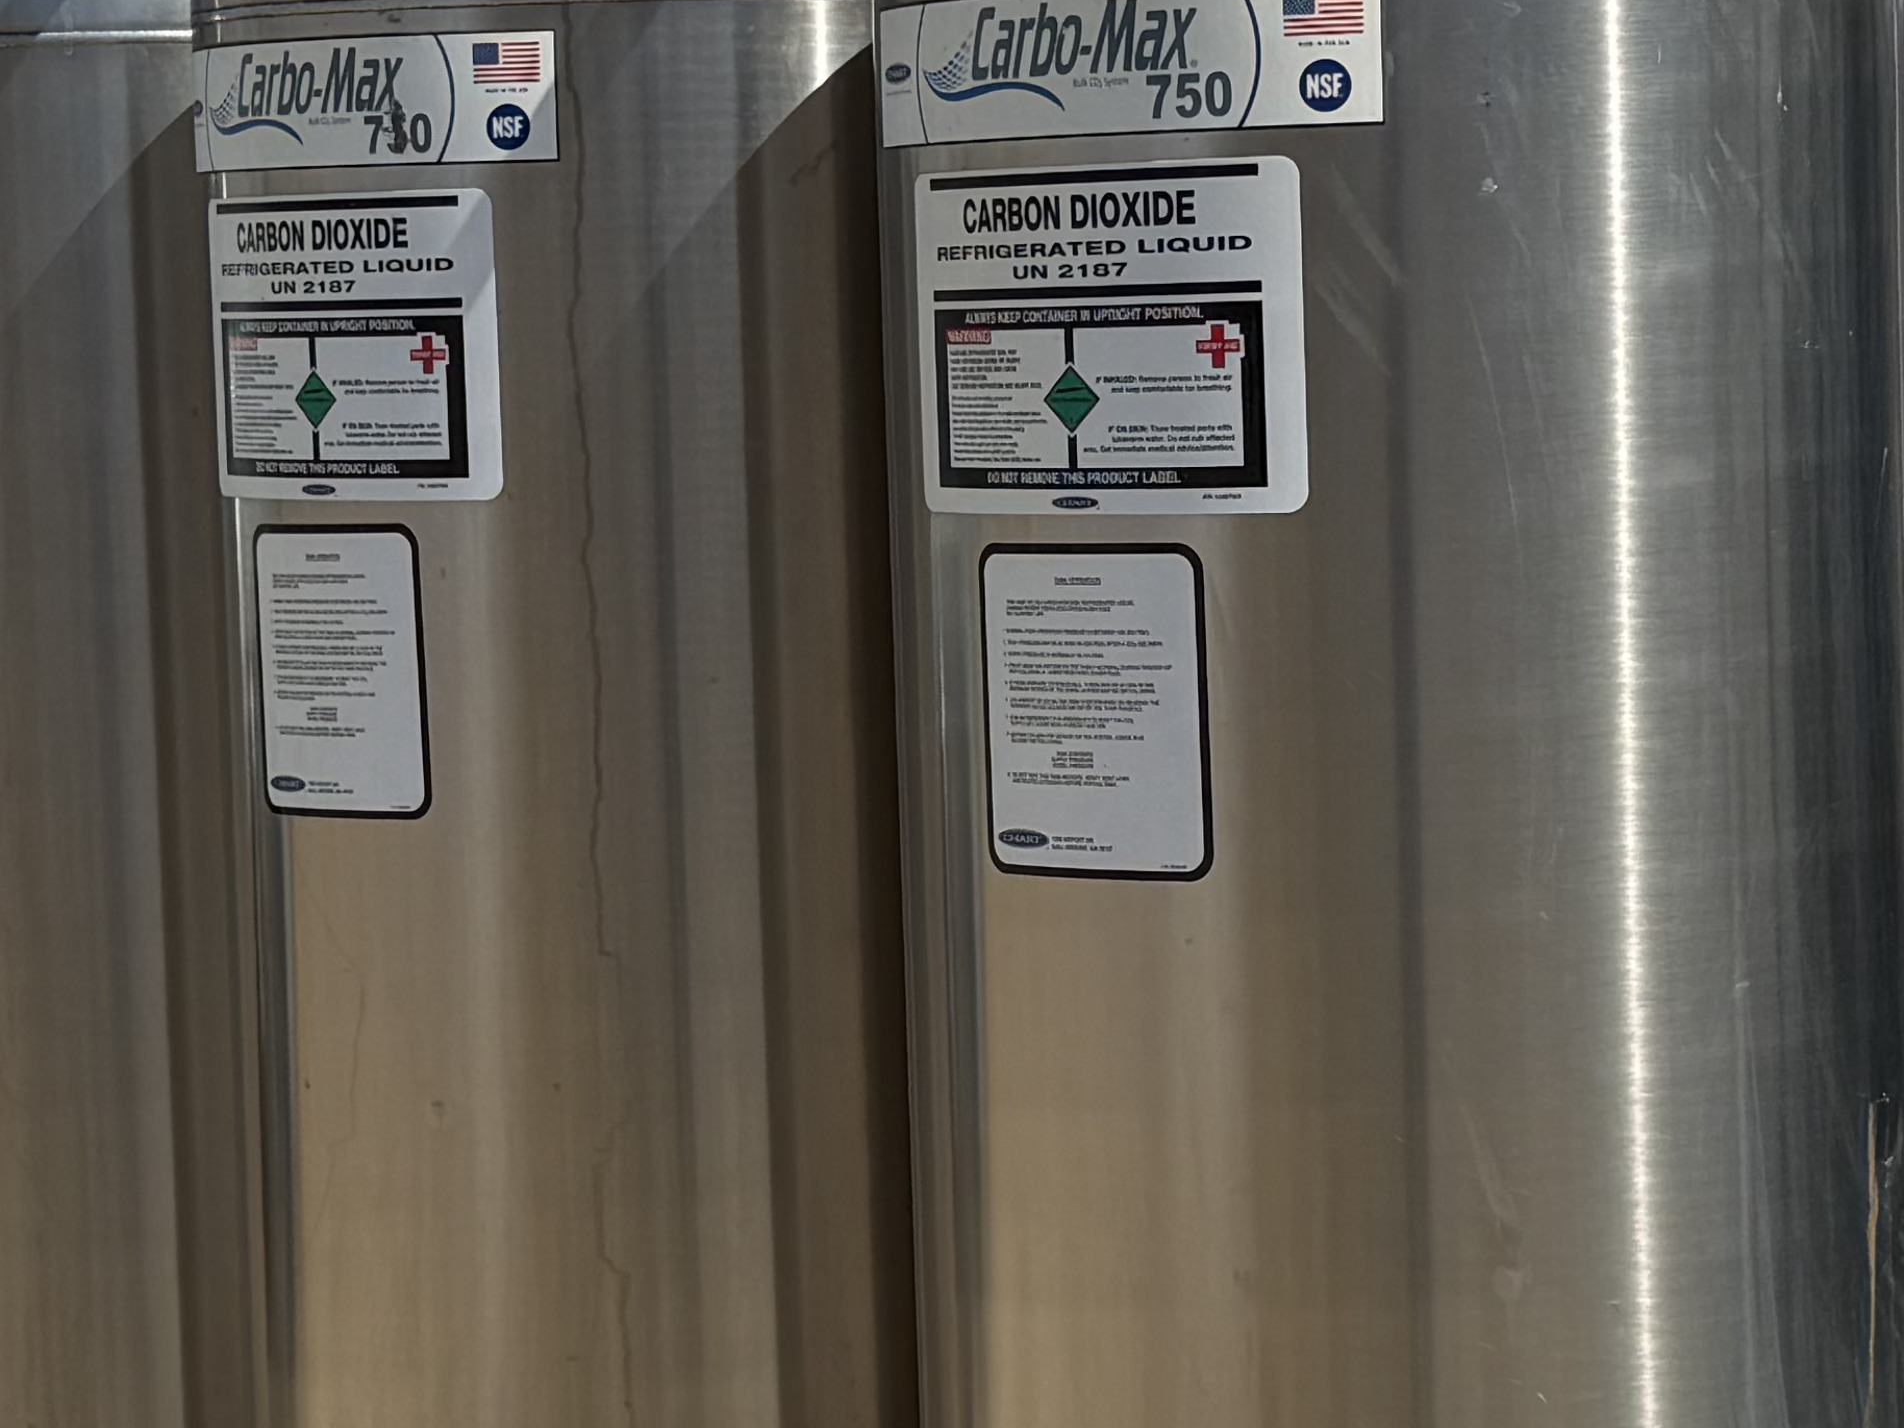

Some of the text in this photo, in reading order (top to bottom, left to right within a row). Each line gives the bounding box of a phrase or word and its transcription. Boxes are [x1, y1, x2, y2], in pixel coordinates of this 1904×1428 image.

[238, 47, 403, 118] Carbo-Max
[1146, 71, 1232, 120] 750
[1306, 73, 1343, 99] NSF
[492, 116, 524, 139] NSF
[963, 190, 1196, 234] CARBON DIOXIDE
[237, 217, 408, 253] CARBON DIOXIDE
[937, 236, 1252, 262] REFRIGERATED LIQUID
[222, 258, 454, 276] REFRIGERATED LIQUID
[1012, 262, 1128, 279] UN 2187
[271, 280, 356, 294] UN 2187
